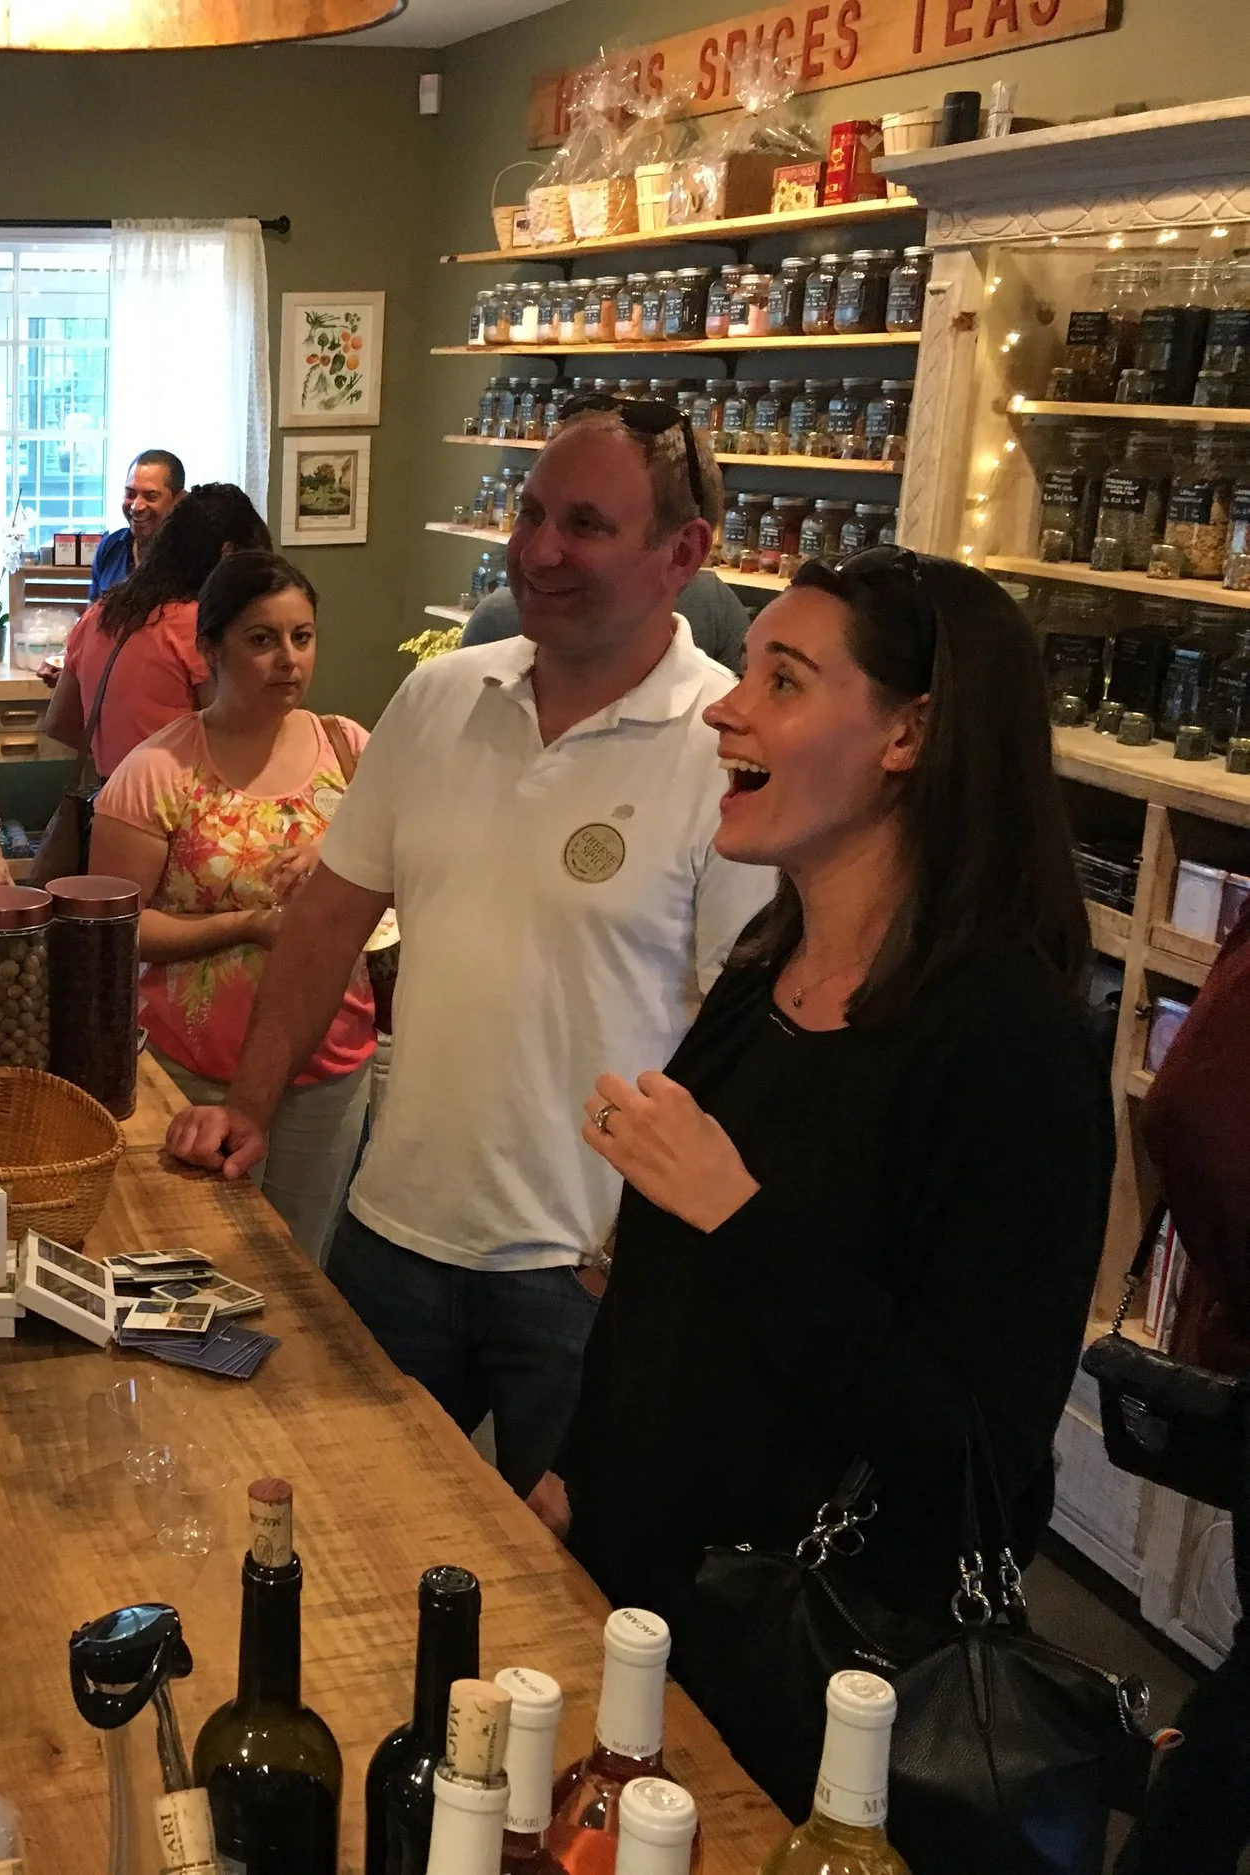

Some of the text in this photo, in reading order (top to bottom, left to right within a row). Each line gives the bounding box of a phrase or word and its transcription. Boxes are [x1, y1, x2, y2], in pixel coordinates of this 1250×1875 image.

[696, 0, 862, 100] SPICES
[581, 846, 609, 873] SPICE
[582, 831, 618, 863] CHEESE
